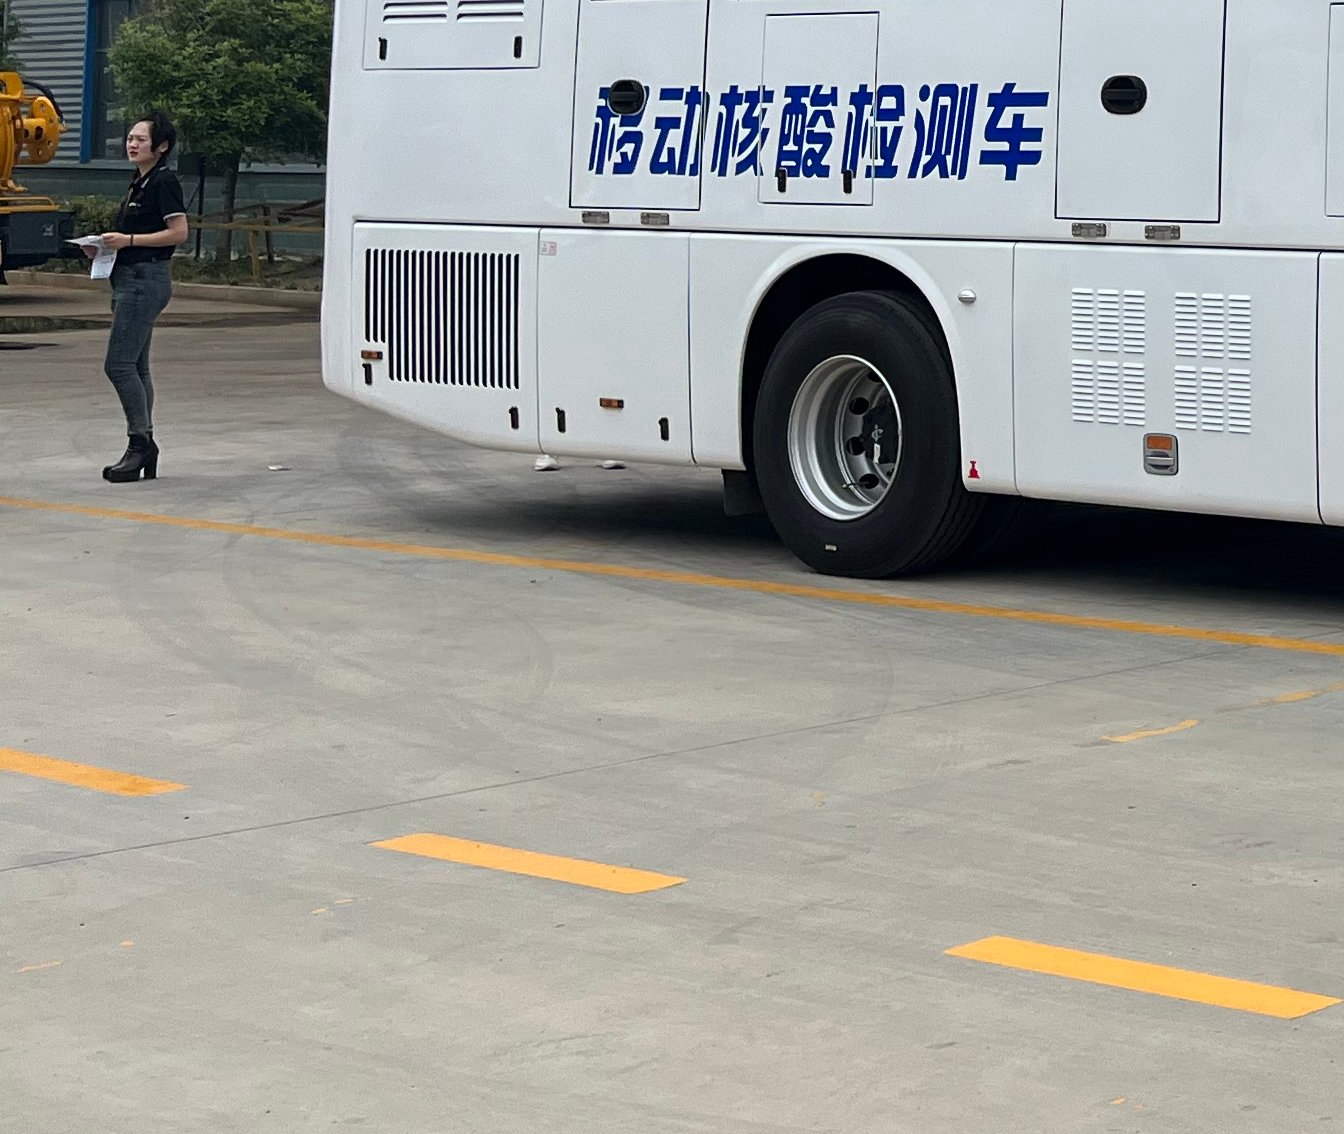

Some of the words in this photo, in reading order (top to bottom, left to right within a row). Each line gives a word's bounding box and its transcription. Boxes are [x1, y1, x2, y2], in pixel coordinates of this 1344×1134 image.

[588, 82, 1049, 181] 移动核酸检测车
